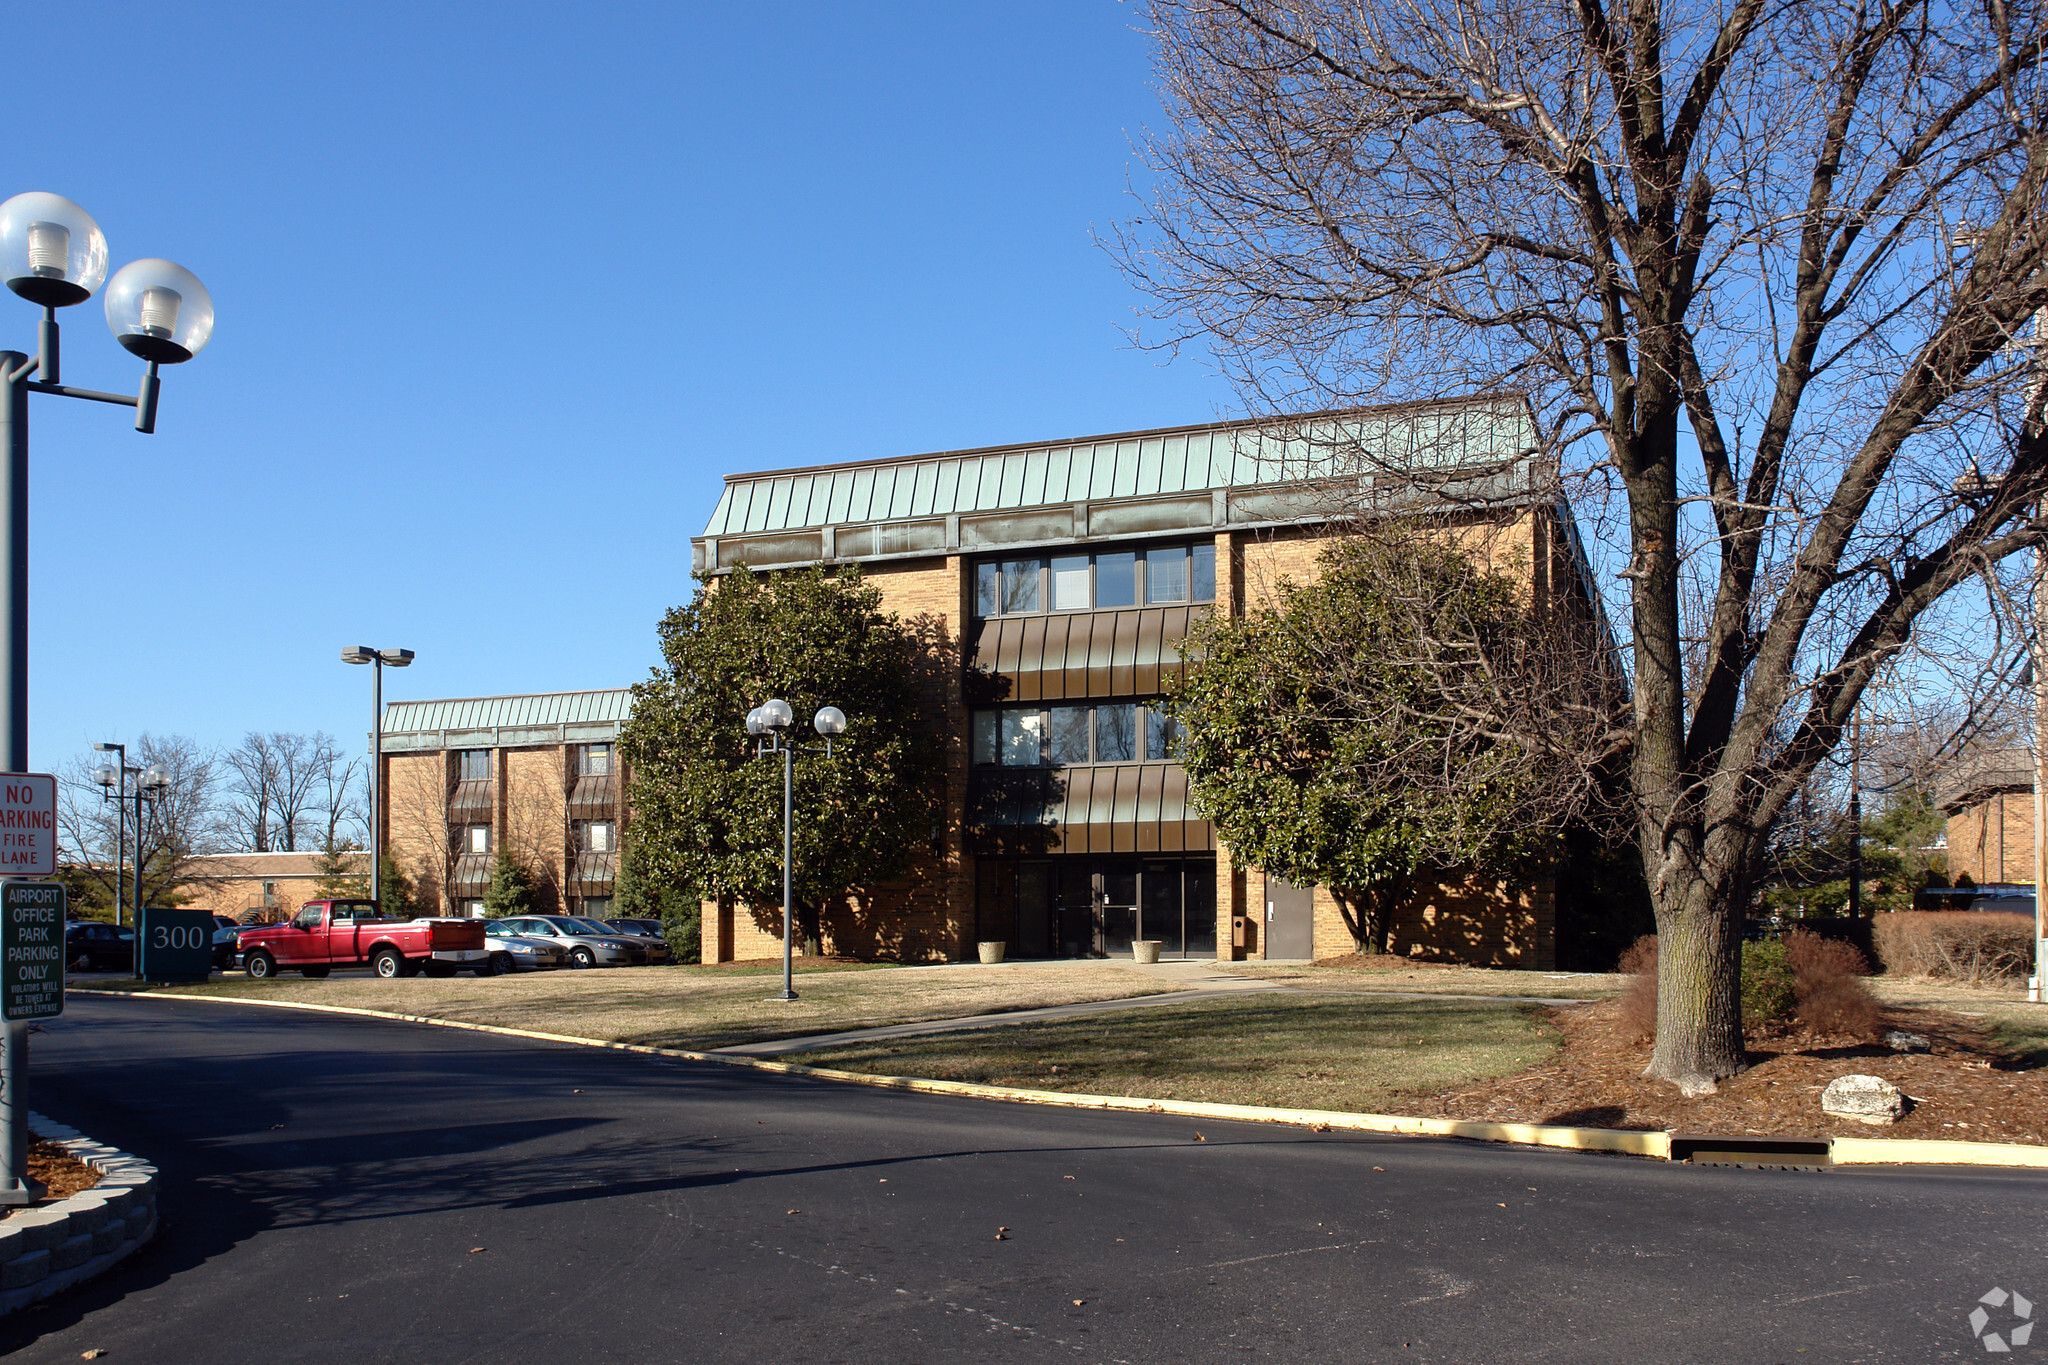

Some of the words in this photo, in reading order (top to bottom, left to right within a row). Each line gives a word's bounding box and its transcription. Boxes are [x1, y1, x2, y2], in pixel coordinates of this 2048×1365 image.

[6, 785, 33, 804] NO
[0, 810, 51, 829] ARKING
[4, 833, 36, 847] FIRE
[1, 851, 38, 865] LANE
[8, 889, 59, 904] AIRPORT
[13, 908, 55, 923] OFFICE
[18, 927, 49, 942] PARK
[153, 926, 203, 949] 300
[8, 946, 59, 962] PARKING
[18, 965, 48, 981] ONLY
[10, 983, 40, 994] VIOLATORS
[42, 981, 59, 991] WILL
[15, 995, 24, 1005] BE
[24, 994, 44, 1004] TOWED
[45, 993, 52, 1002] AT
[34, 1003, 58, 1014] EXPENSE
